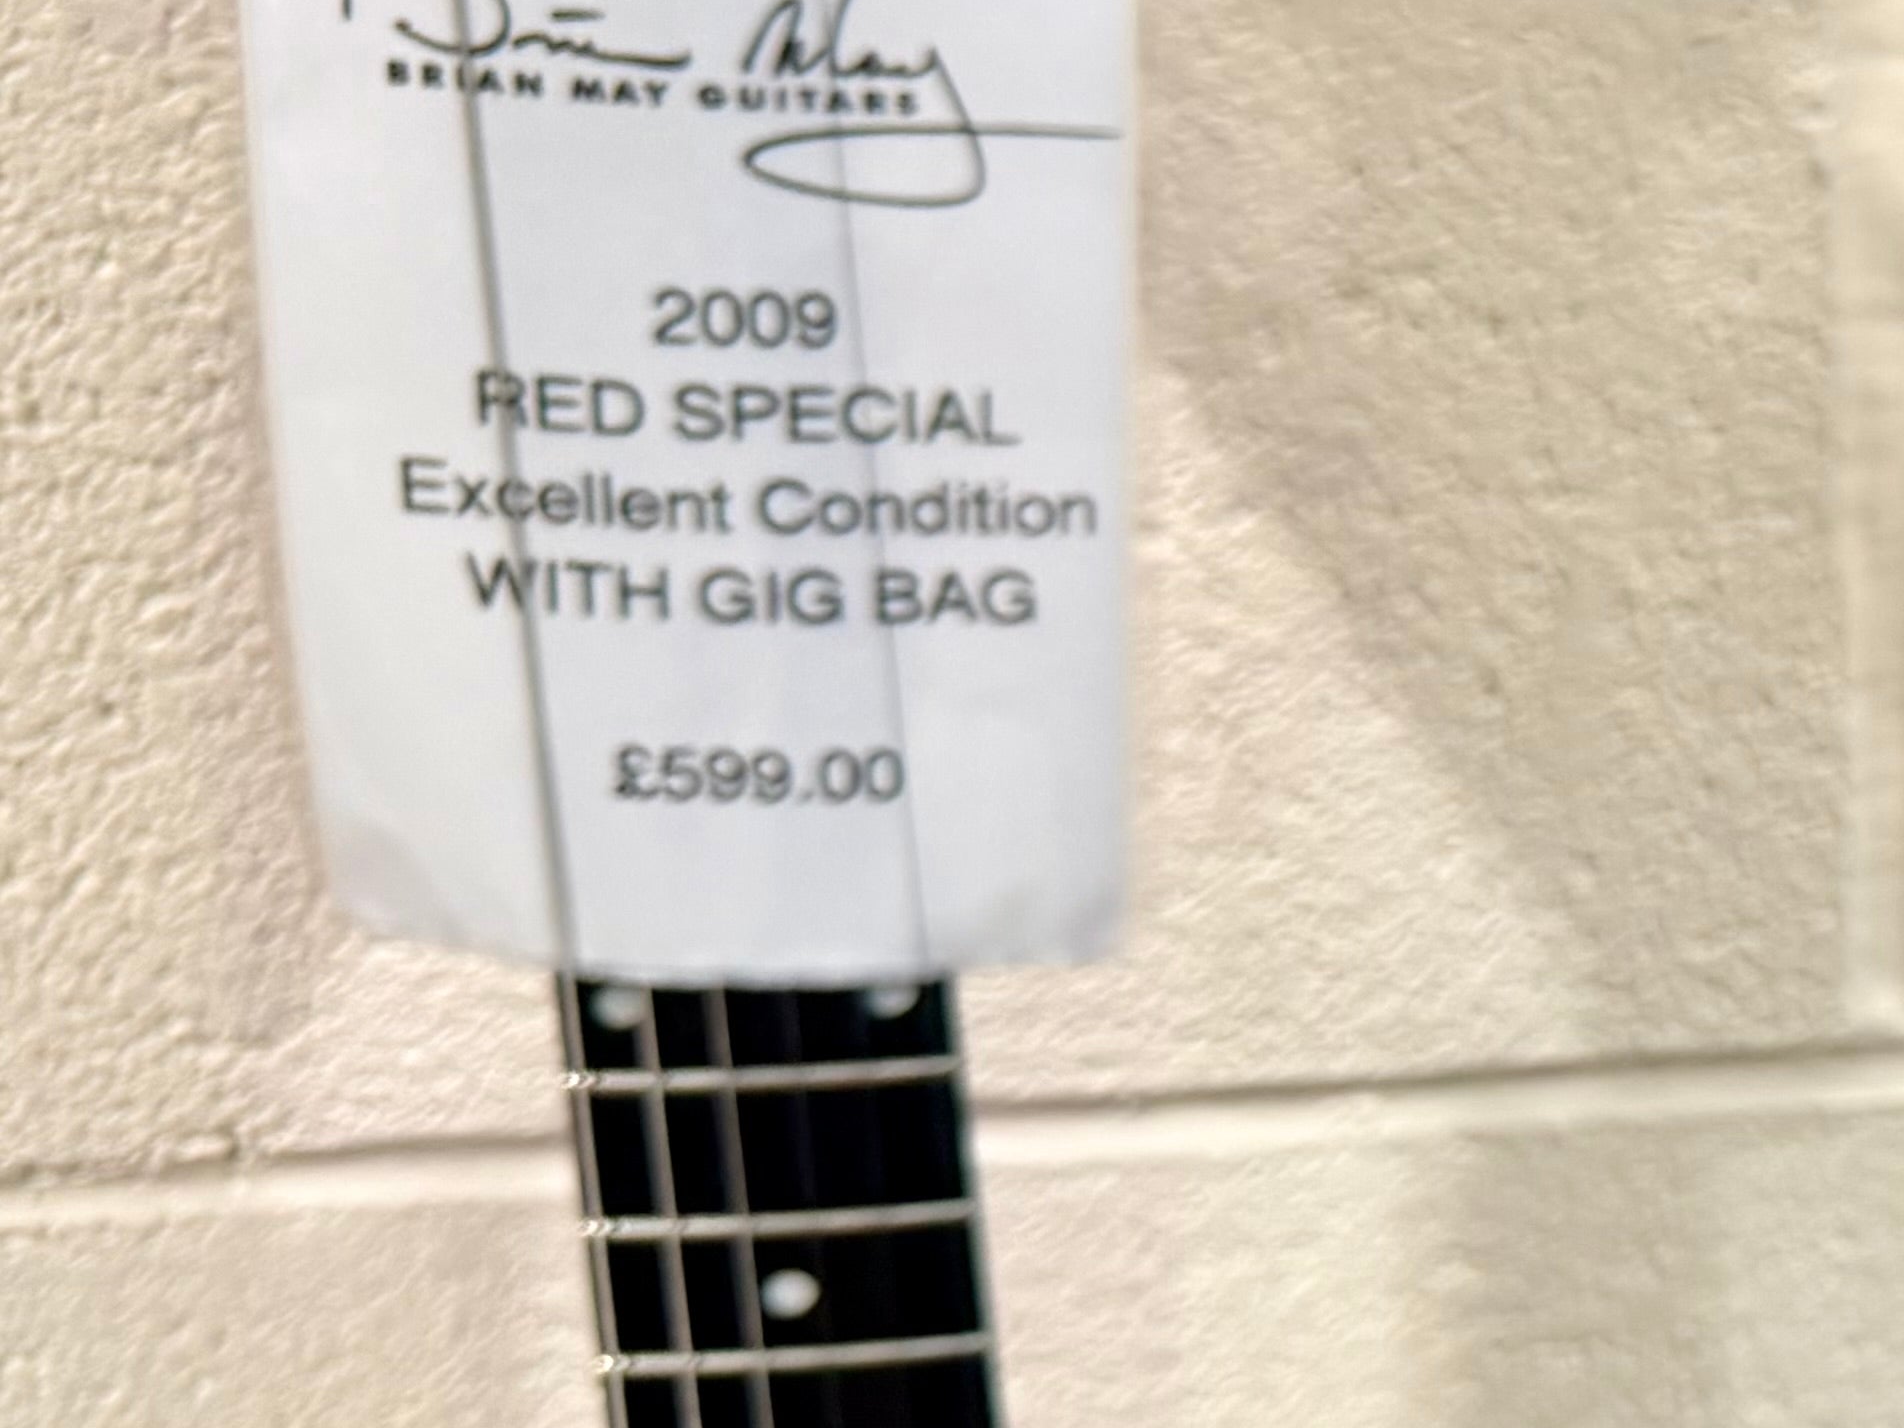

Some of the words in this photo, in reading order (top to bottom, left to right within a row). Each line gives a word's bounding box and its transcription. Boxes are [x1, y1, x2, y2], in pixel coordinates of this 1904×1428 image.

[384, 58, 543, 100] BRIAN
[571, 79, 667, 109] MAY
[697, 82, 920, 117] GUITARS
[650, 286, 838, 350] 2009
[474, 370, 645, 437] RED
[671, 382, 1021, 446] SPECIAL
[399, 457, 732, 533] Excellent
[754, 477, 1098, 537] Condition
[463, 552, 670, 620] WITH
[696, 568, 844, 625] GIG
[872, 570, 1037, 626] BAG
[612, 744, 906, 804] £599.00
